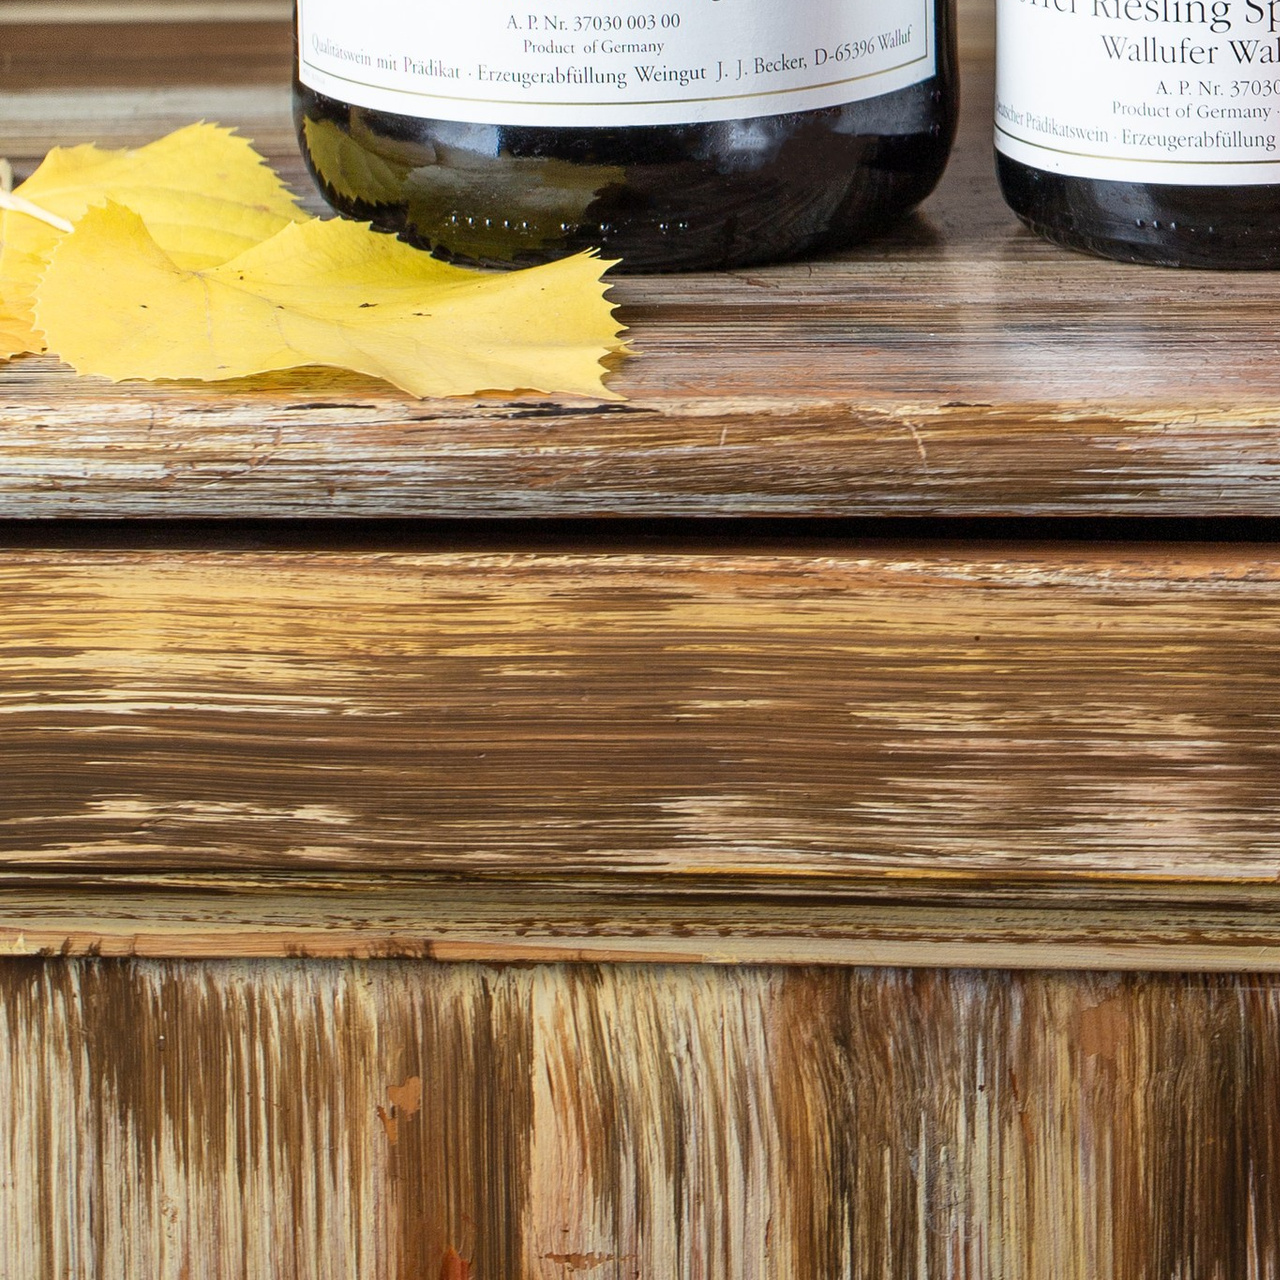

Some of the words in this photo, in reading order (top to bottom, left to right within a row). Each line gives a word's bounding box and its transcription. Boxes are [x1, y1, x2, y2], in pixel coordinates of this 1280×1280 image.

[506, 14, 523, 30] A.
[527, 14, 539, 31] P.
[544, 15, 568, 31] Nr.
[573, 15, 622, 32] 37030
[626, 14, 655, 31] 003
[660, 12, 681, 29] 00
[311, 33, 371, 66] Qualitätswein
[376, 57, 397, 72] mit
[403, 56, 460, 80] Prädikat
[478, 64, 628, 90] Erzeugerabfüllung
[634, 64, 707, 87] Weingut
[715, 60, 729, 83] J.
[735, 59, 748, 81] J.
[754, 53, 808, 74] Becker,
[815, 36, 875, 66] D-65396
[877, 23, 912, 51] Walluf
[523, 39, 575, 54] Product
[583, 39, 596, 54] of
[600, 39, 665, 57] Germany
[1101, 35, 1219, 65] Wallufer
[1156, 80, 1172, 96] A.
[1179, 80, 1194, 96] P.
[1198, 80, 1224, 96] Nr.
[1112, 100, 1170, 119] Product
[1175, 102, 1193, 119] of
[1196, 104, 1272, 122] Germany
[1025, 112, 1109, 143] Prädikatswein
[1122, 128, 1277, 153] Erzeugerabfüllung
